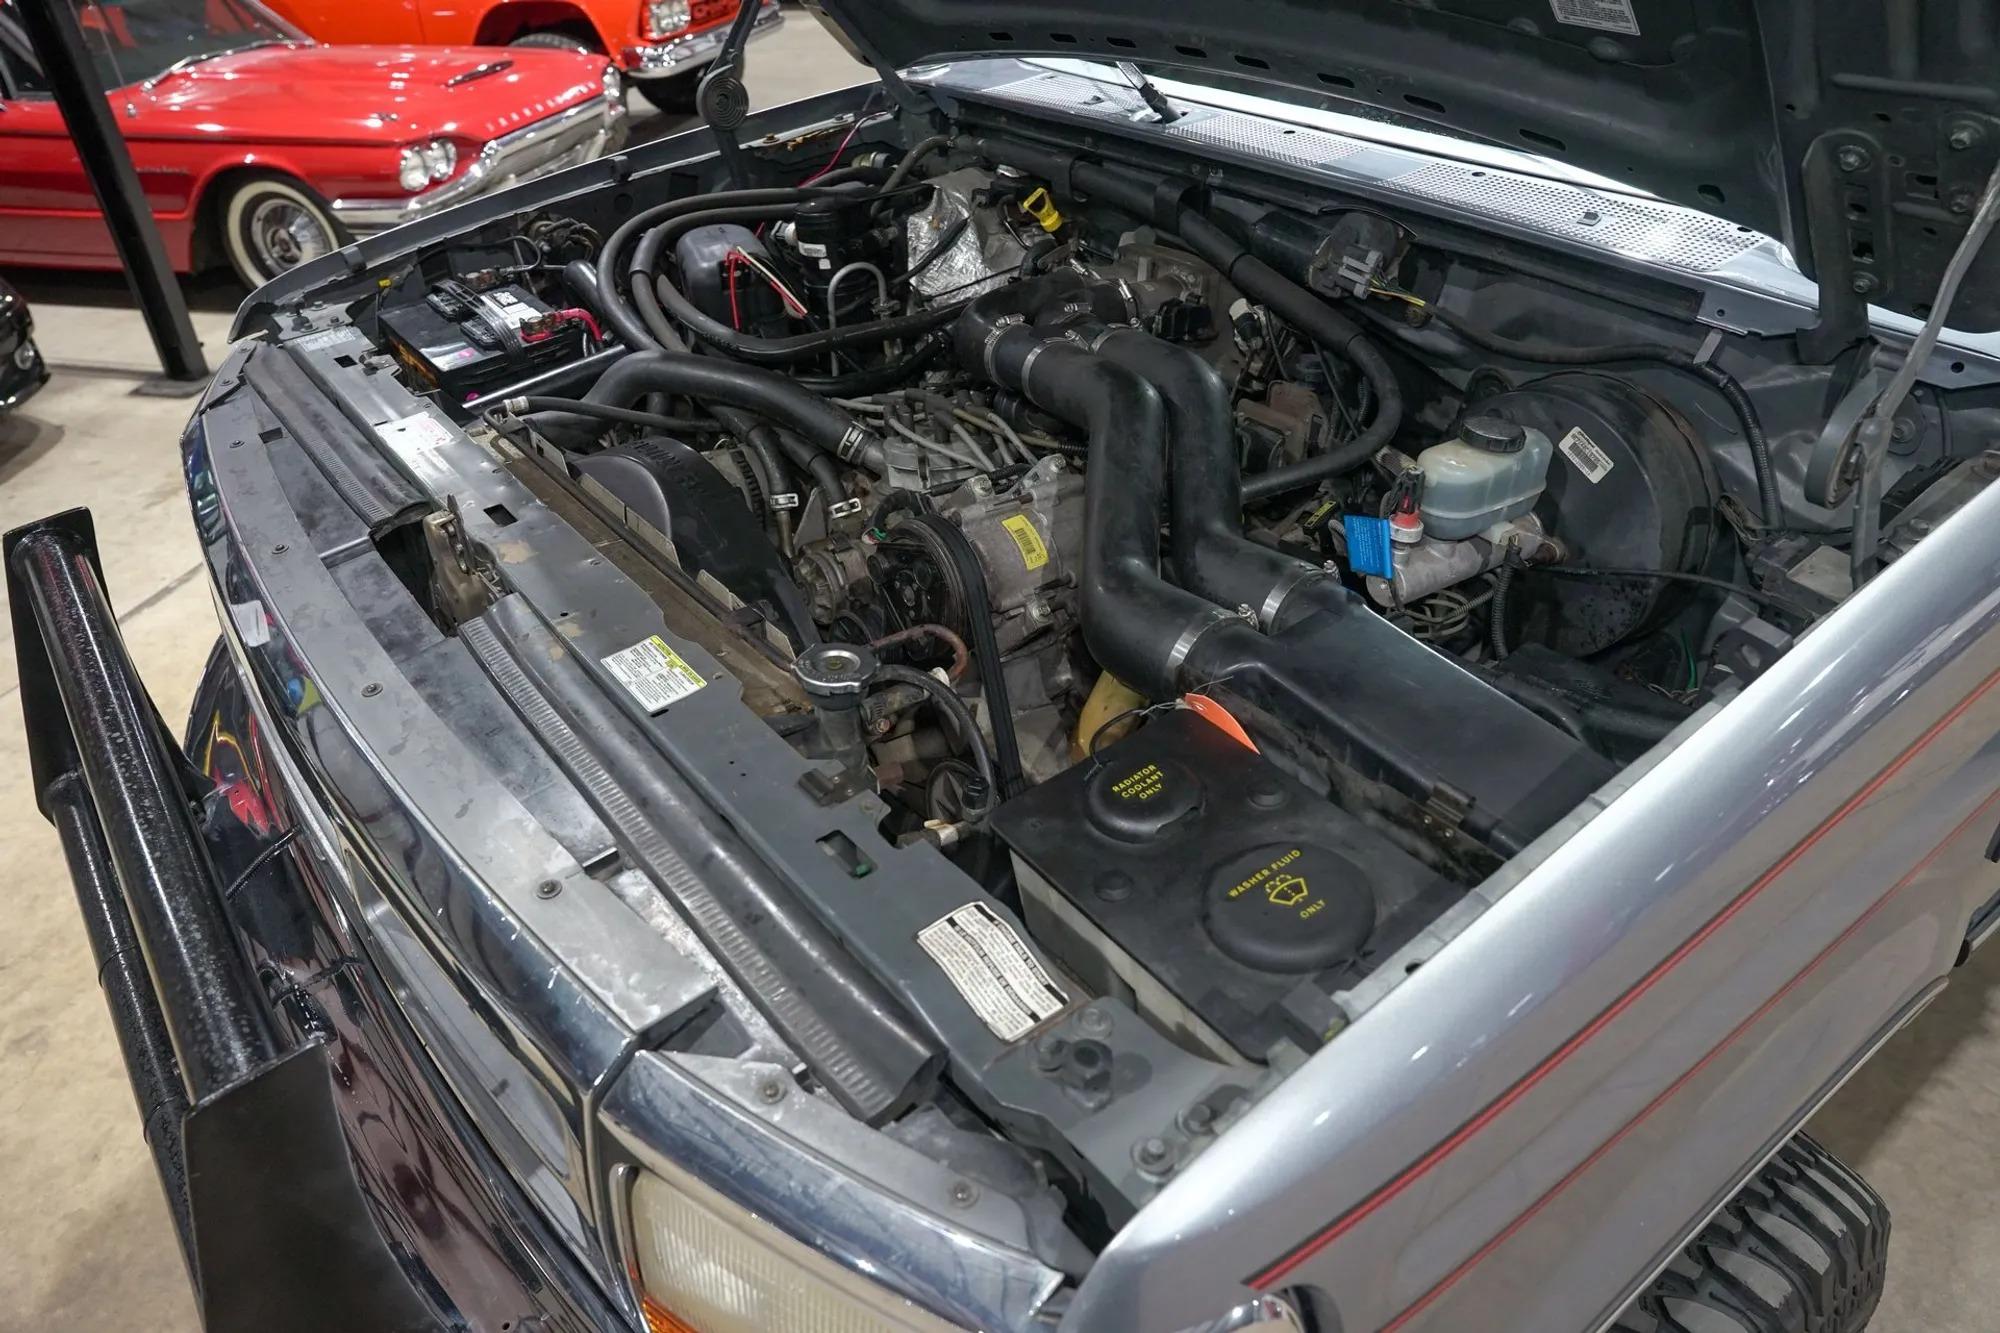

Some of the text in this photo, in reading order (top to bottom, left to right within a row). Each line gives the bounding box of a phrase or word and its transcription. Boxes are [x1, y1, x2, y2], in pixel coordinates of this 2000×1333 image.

[1112, 764, 1157, 792] RADIATOR
[1121, 771, 1163, 798] COOLANT
[1139, 783, 1162, 799] ONLY
[1228, 849, 1301, 897] WASHER FLUID
[1300, 899, 1325, 919] ONLY
